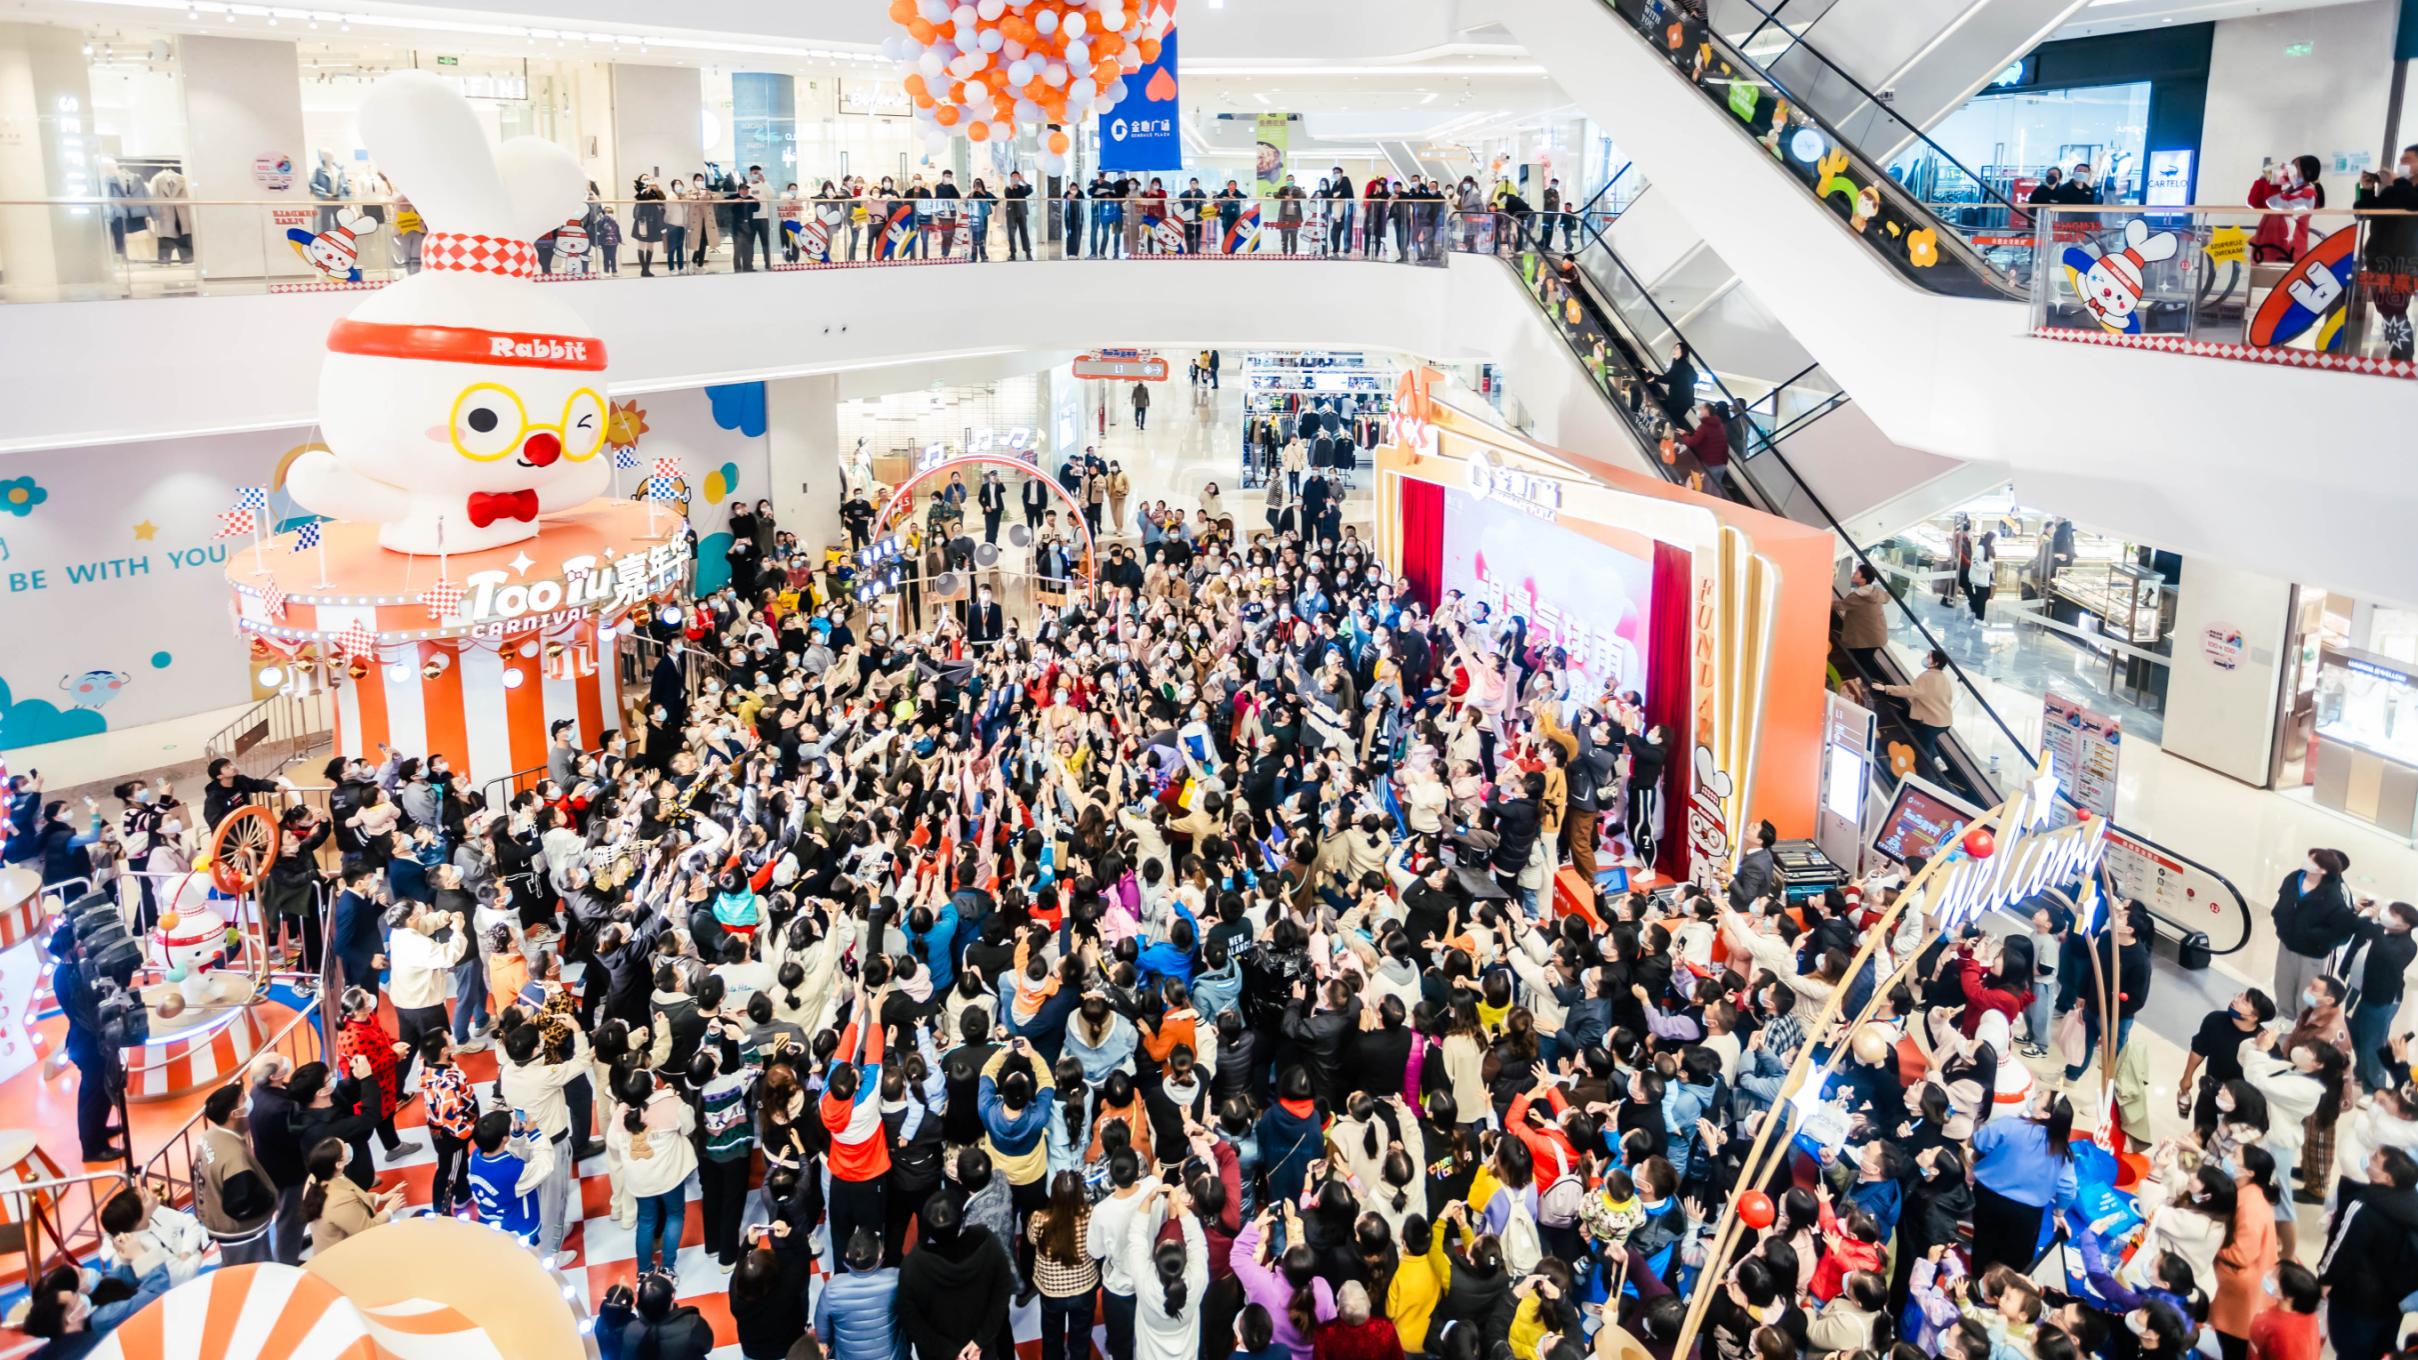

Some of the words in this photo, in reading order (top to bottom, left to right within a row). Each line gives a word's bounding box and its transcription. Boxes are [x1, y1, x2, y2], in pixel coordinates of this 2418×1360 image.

[1640, 13, 1655, 30] YOU
[1644, 5, 1661, 25] WITH
[1131, 120, 1170, 132] 金地广场
[2149, 180, 2188, 188] CARTELO
[488, 336, 588, 361] Rabbit
[9, 570, 48, 593] BE
[65, 556, 150, 585] WITH
[168, 544, 227, 569] YOU
[467, 569, 562, 621] Too
[471, 607, 592, 639] CARNIVAL
[1229, 933, 1244, 947] NEW
